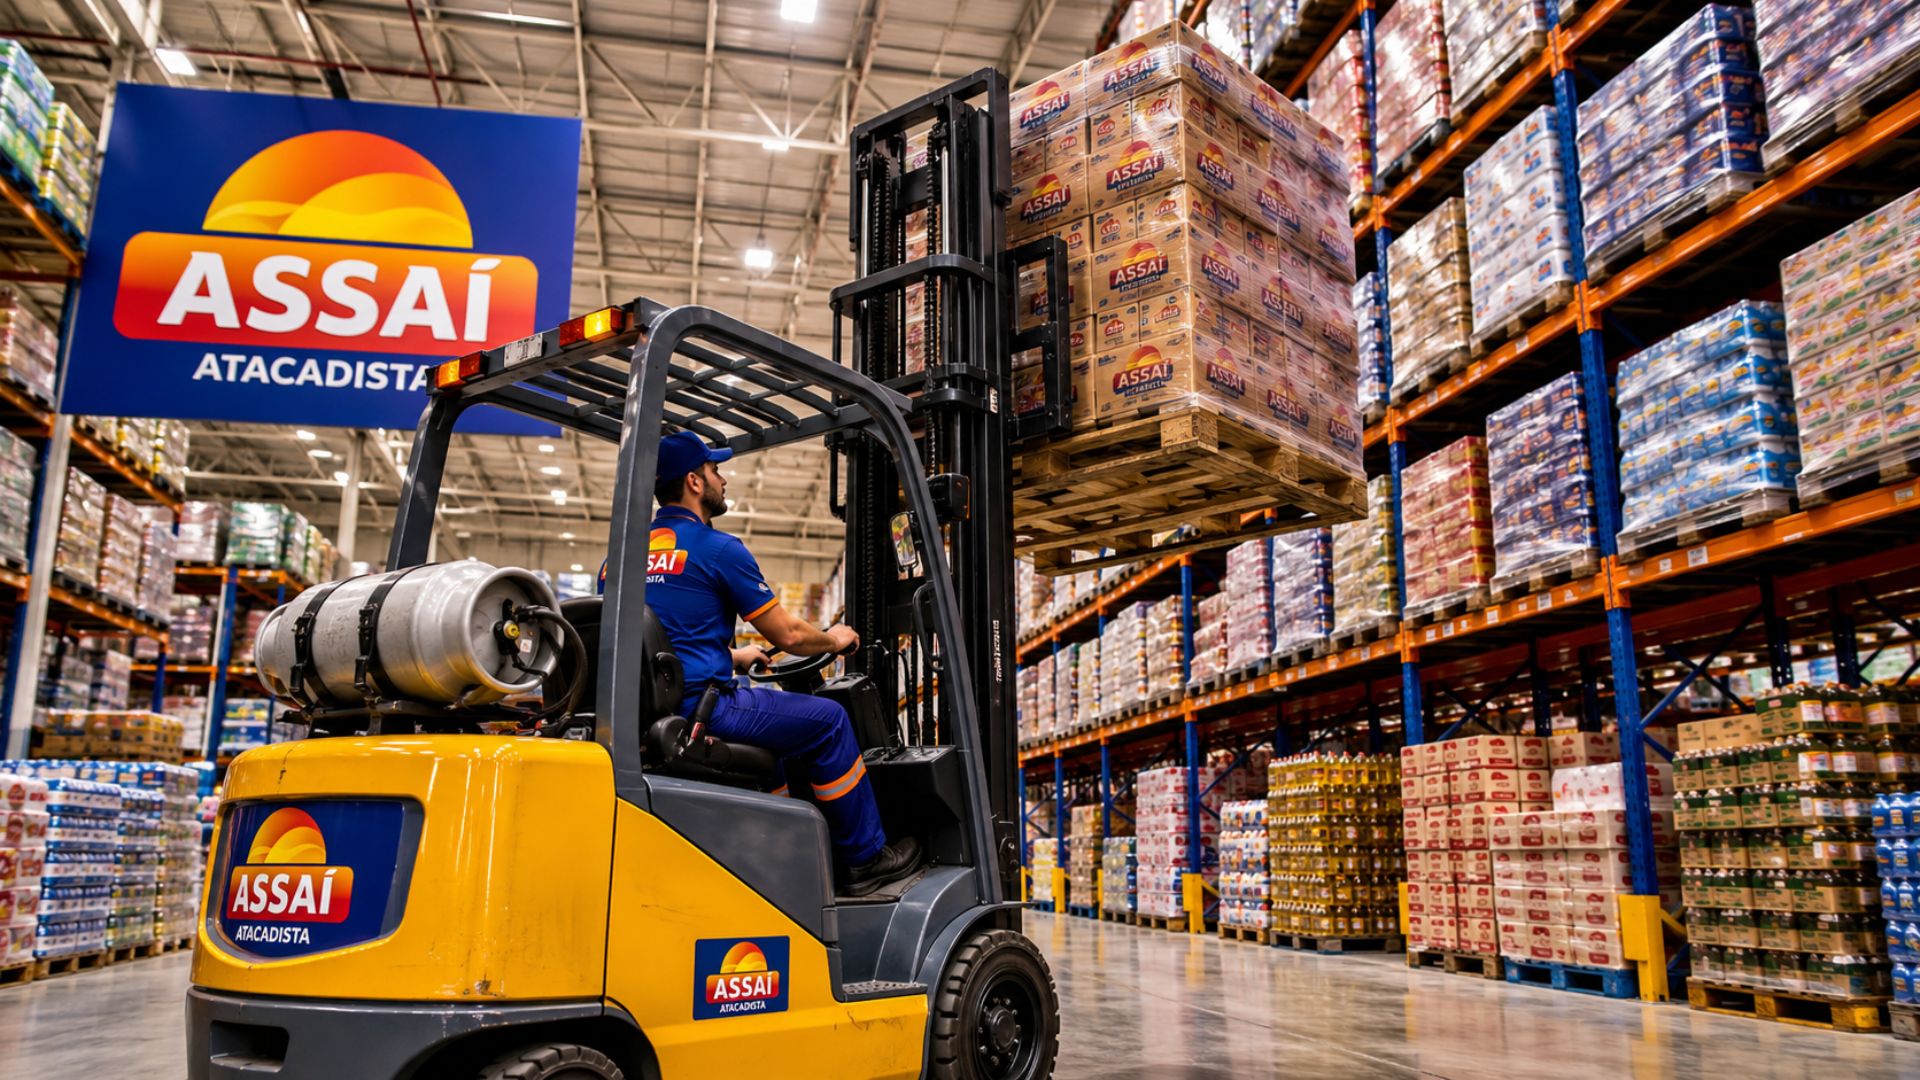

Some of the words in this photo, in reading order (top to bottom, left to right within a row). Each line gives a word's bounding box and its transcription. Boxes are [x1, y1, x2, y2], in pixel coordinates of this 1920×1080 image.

[157, 251, 501, 343] ASSAÍ
[193, 353, 429, 391] ATACADISTA
[647, 549, 680, 572] SAÍ
[232, 869, 338, 914] ASSAÍ
[235, 925, 310, 944] ATACADISTA
[713, 971, 773, 1000] ASSAÍ
